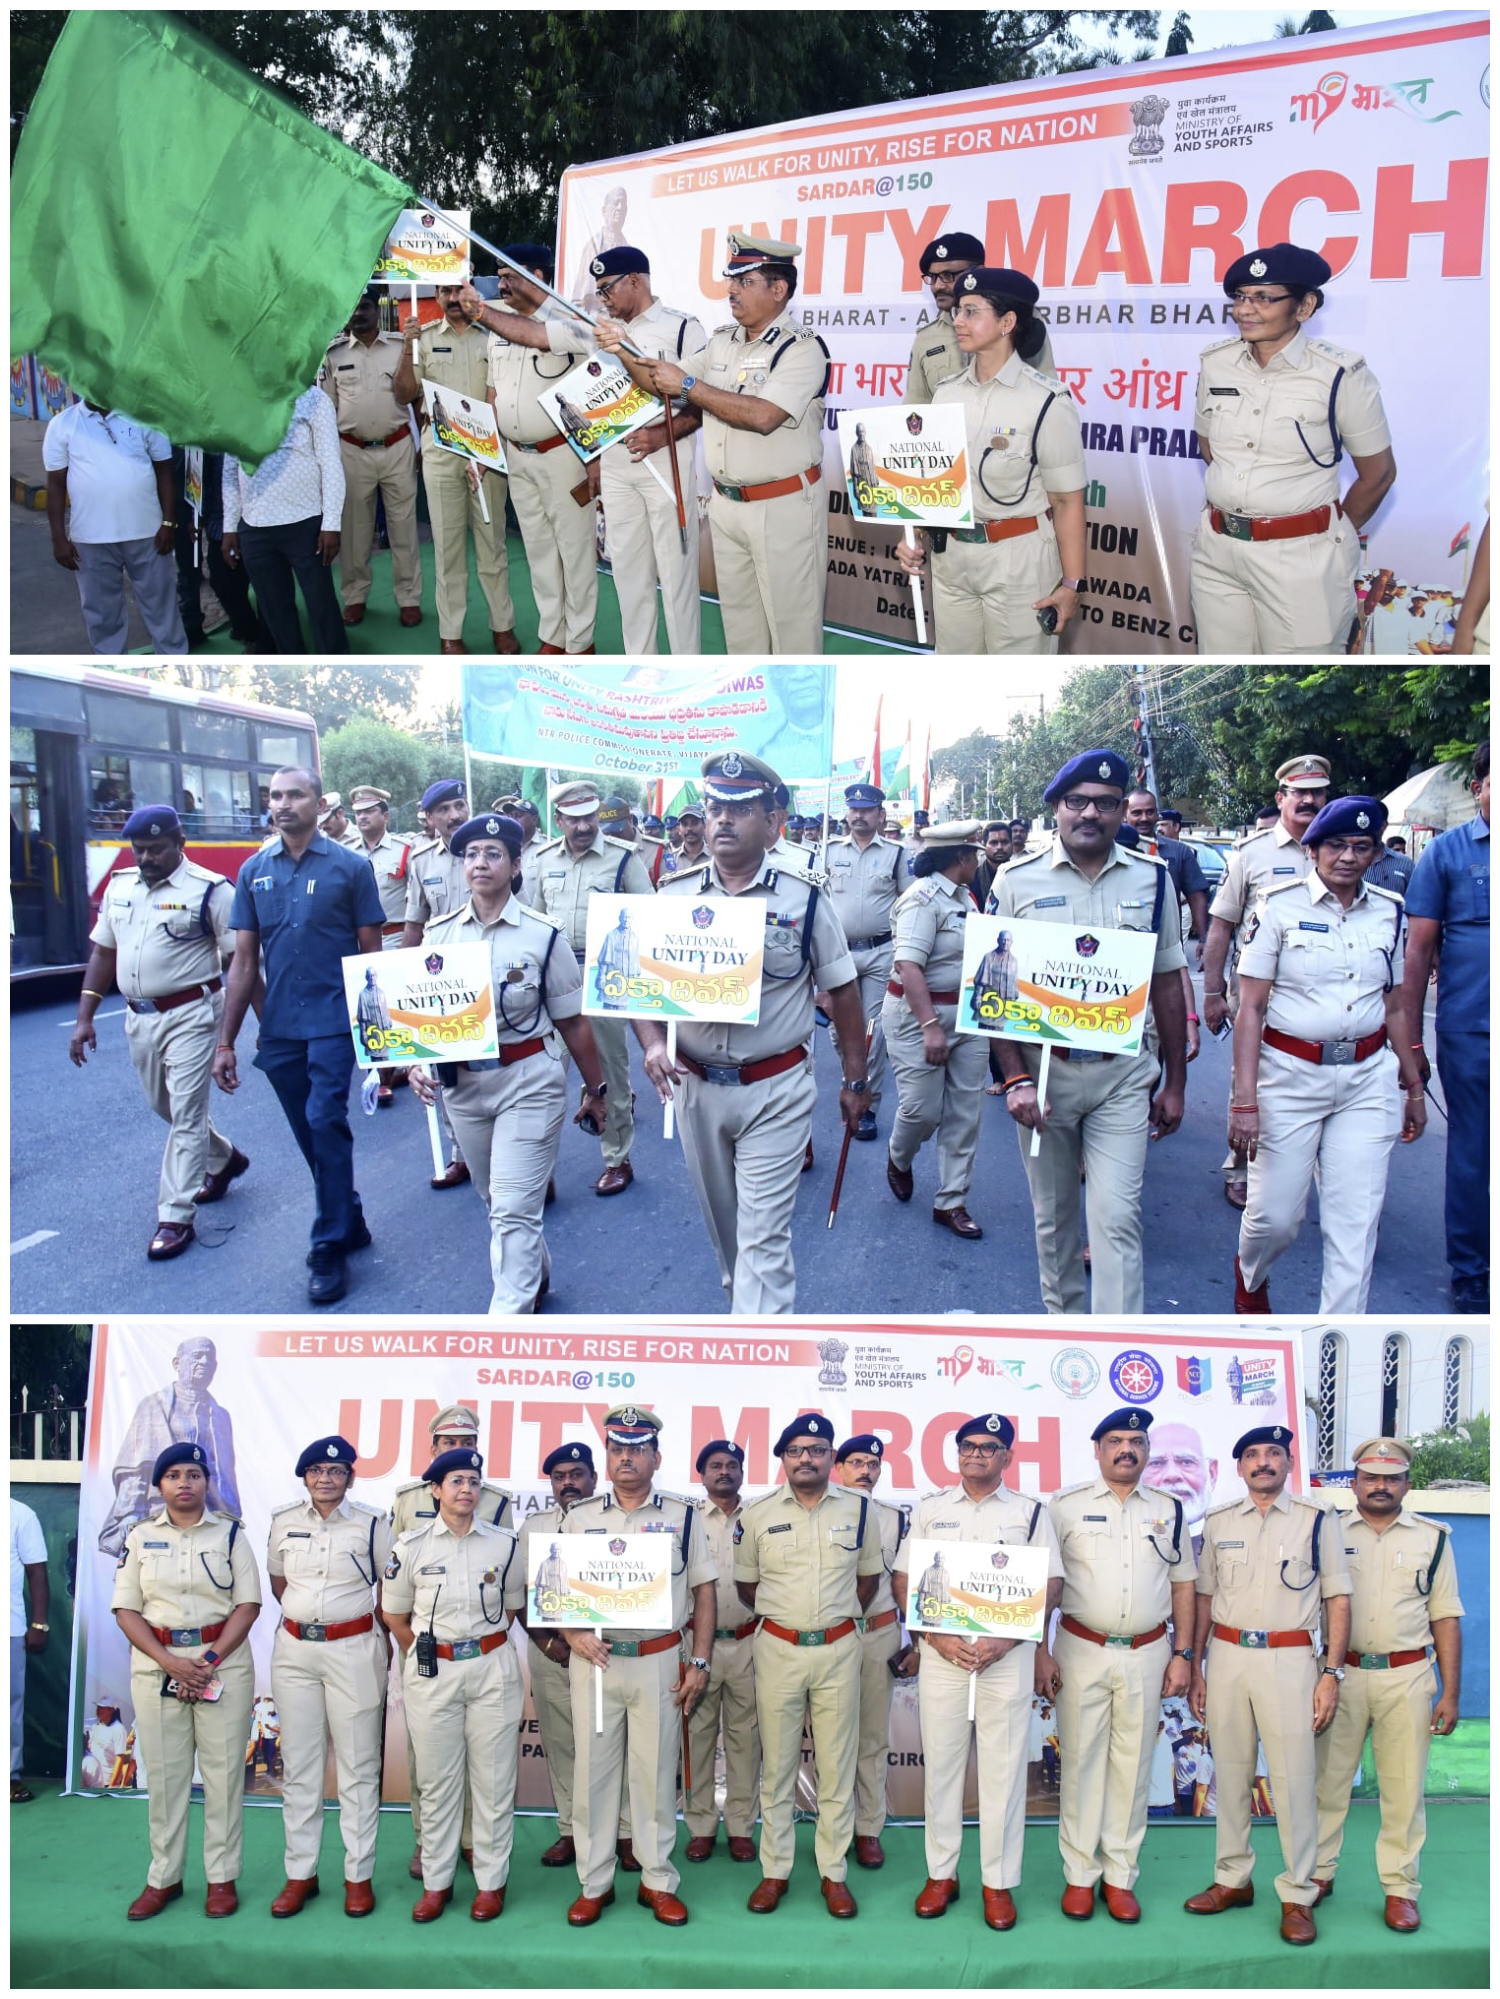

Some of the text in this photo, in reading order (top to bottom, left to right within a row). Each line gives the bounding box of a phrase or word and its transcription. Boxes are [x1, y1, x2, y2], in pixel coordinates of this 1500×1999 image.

[1177, 94, 1227, 110] युवा कार्यक्रम
[1352, 77, 1463, 123] भारत
[1176, 104, 1237, 120] एवं खेल मंत्रालय
[1174, 121, 1274, 141] YOUTH AFFAIRS
[1175, 115, 1242, 131] MINISTRY OF
[668, 113, 1098, 193] LET US WALK FOR UNITY, RISE FOR NATION
[1173, 135, 1254, 153] AND SPORTS
[796, 171, 933, 202] SARDAR@150
[405, 231, 451, 239] NATIONAL
[984, 156, 1488, 294] MARCH
[398, 239, 460, 249] UNITY DAY
[803, 309, 889, 326] BHARAT
[1150, 304, 1238, 324] BHAR
[584, 368, 624, 397] NATIONAL
[585, 373, 632, 411] UNITY DA
[855, 362, 909, 397] भार
[1103, 358, 1188, 411] आंध्र
[889, 442, 944, 453] NATIONAL
[882, 454, 955, 469] UNITY DAY
[858, 480, 899, 514] ఏక్తా
[901, 479, 962, 507] దివస్
[828, 560, 858, 577] ADA
[1080, 604, 1104, 624] TO
[1112, 610, 1171, 639] BENZ
[539, 667, 560, 684] FOR
[563, 676, 604, 696] UNITY
[605, 690, 679, 706] RASHTRIY
[538, 727, 556, 738] NTR
[559, 731, 590, 744] POLICE
[595, 753, 652, 773] October
[599, 810, 617, 819] POLICE
[664, 934, 737, 949] NATIONAL
[652, 947, 749, 966] UNITY DAY
[1045, 959, 1122, 980] NATIONAL
[405, 978, 468, 994] NATIONAL
[604, 969, 749, 1008] ఏక్తా దివస్
[1031, 972, 1133, 997] UNITY DAY
[397, 990, 480, 1011] UNITY DAY
[979, 991, 1132, 1035] ఏక్తా దివస్
[366, 1013, 486, 1055] ఏక్తా దివస్
[285, 1336, 790, 1362] LET US WALK FOR UNITY, RISE FOR NATION
[854, 1363, 892, 1371] MINISTRY
[854, 1370, 927, 1381] YOUTH AFFAIRS
[977, 1355, 1043, 1390] भारत
[1244, 1359, 1274, 1373] UNITY
[1245, 1370, 1275, 1381] MARCH
[476, 1368, 636, 1390] SARDAR@150
[854, 1379, 914, 1389] AND SPORTS
[689, 1405, 1061, 1493] MRCH
[588, 1560, 647, 1570] NATIONAL
[578, 1571, 656, 1582] UNITY DAY
[969, 1571, 1028, 1585] NATIONAL
[960, 1581, 1036, 1598] UNITY DAY
[541, 1590, 658, 1618] ఏక్తా దివస్
[922, 1597, 1036, 1627] ఏక్తా దివస్
